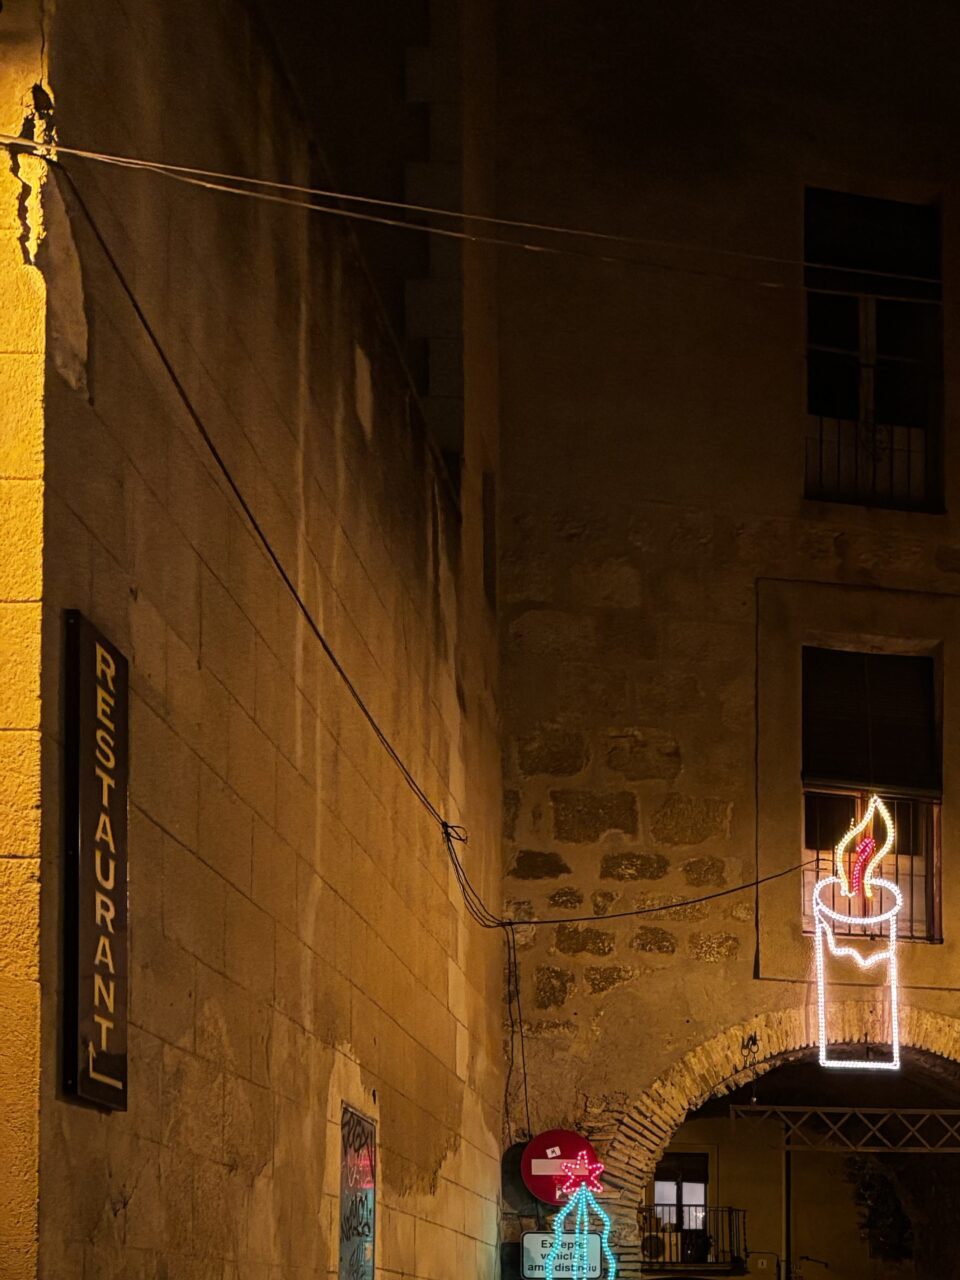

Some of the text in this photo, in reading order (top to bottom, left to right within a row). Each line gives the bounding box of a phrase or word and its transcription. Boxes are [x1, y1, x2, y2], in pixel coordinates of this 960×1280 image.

[95, 641, 116, 1053] RESTAURANT
[541, 1239, 585, 1250] Exepe
[540, 1251, 585, 1261] vhicls
[527, 1263, 597, 1272] am distniu
